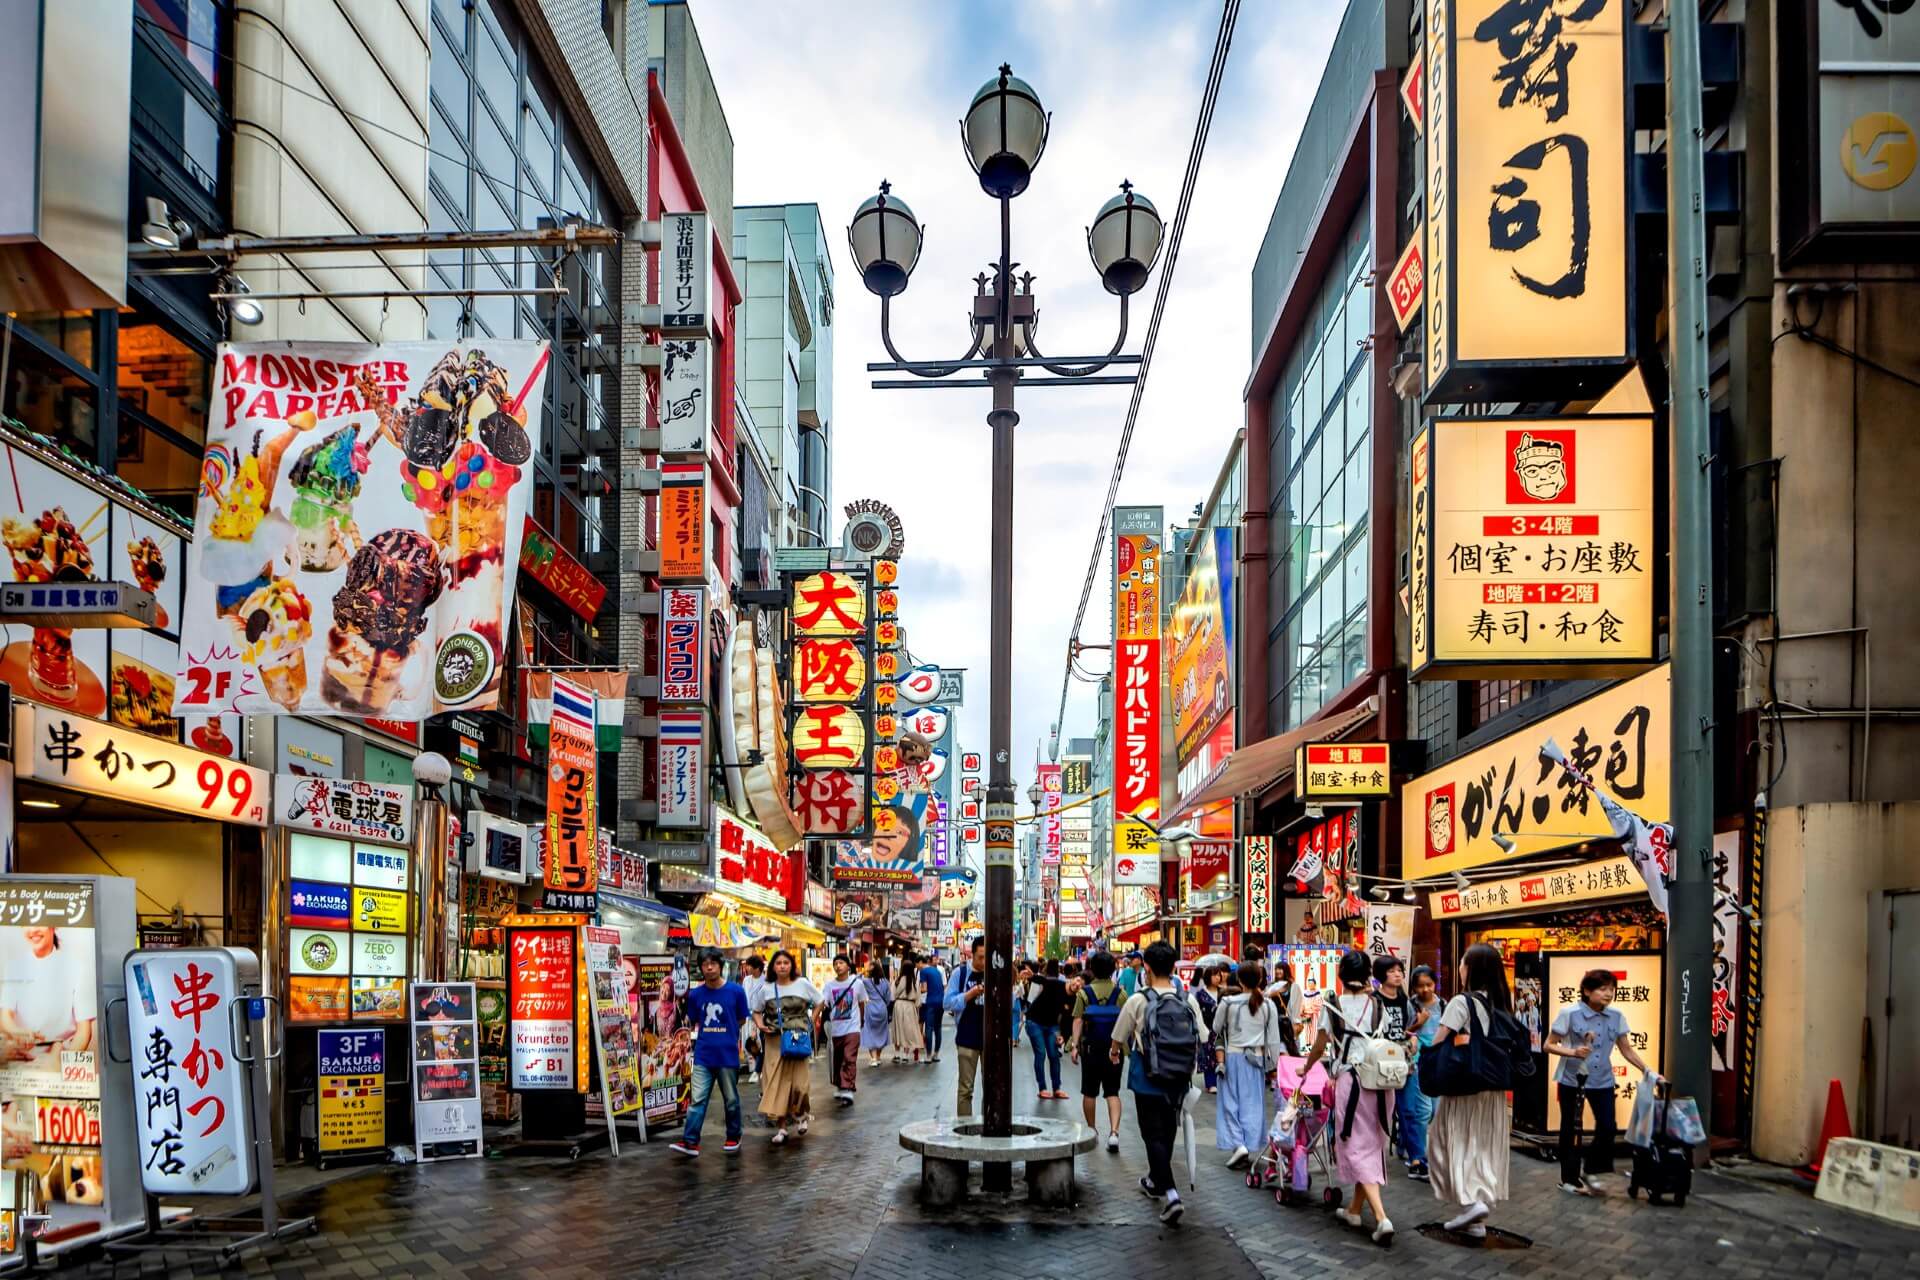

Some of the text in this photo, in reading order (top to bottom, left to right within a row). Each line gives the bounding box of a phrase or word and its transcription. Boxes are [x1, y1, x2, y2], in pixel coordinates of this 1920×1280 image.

[676, 216, 694, 313] 浪花囲碁サロン
[221, 353, 410, 392] MONSTER
[664, 388, 701, 424] Leaf
[675, 489, 690, 560] ミティラー
[1447, 541, 1643, 574] 個室・お座敷
[670, 589, 697, 617] 薬
[1486, 584, 1595, 603] 地階・1・2階
[1467, 608, 1624, 644] 寿司・和食
[438, 638, 485, 665] DOUTONBORI
[669, 622, 695, 681] ダイコク
[180, 666, 231, 704] 2F
[664, 684, 699, 698] 免税
[789, 571, 867, 832] 大阪王将
[1124, 644, 1151, 799] ツルハドラッグ
[44, 720, 263, 822] 串かつ 99円
[1329, 748, 1363, 763] 地階
[675, 746, 688, 805] クンテープ
[1310, 769, 1385, 788] 個室・和食
[331, 790, 403, 827] 電球屋
[561, 768, 587, 888] クンテープ
[1126, 828, 1148, 849] 薬
[1193, 844, 1229, 857] ツルハ
[1193, 857, 1222, 867] ドラッグ
[10, 889, 17, 898] &
[20, 889, 41, 900] Body
[44, 889, 80, 900] Massage
[306, 893, 348, 905] SAKURA
[1250, 841, 1268, 927] 大阪みやげ
[1461, 888, 1510, 909] 寿司・和食
[1549, 864, 1630, 896] 個室・お座敷
[364, 942, 395, 955] ZERO
[514, 935, 571, 956] タイ料理
[171, 962, 225, 1138] 串かつ
[339, 1036, 368, 1054] 3F
[516, 1033, 569, 1045] Krungtep
[321, 1055, 381, 1067] SAKURA
[546, 1058, 563, 1072] B1
[141, 1026, 186, 1177] 専門店
[38, 1105, 101, 1145] 1600円
